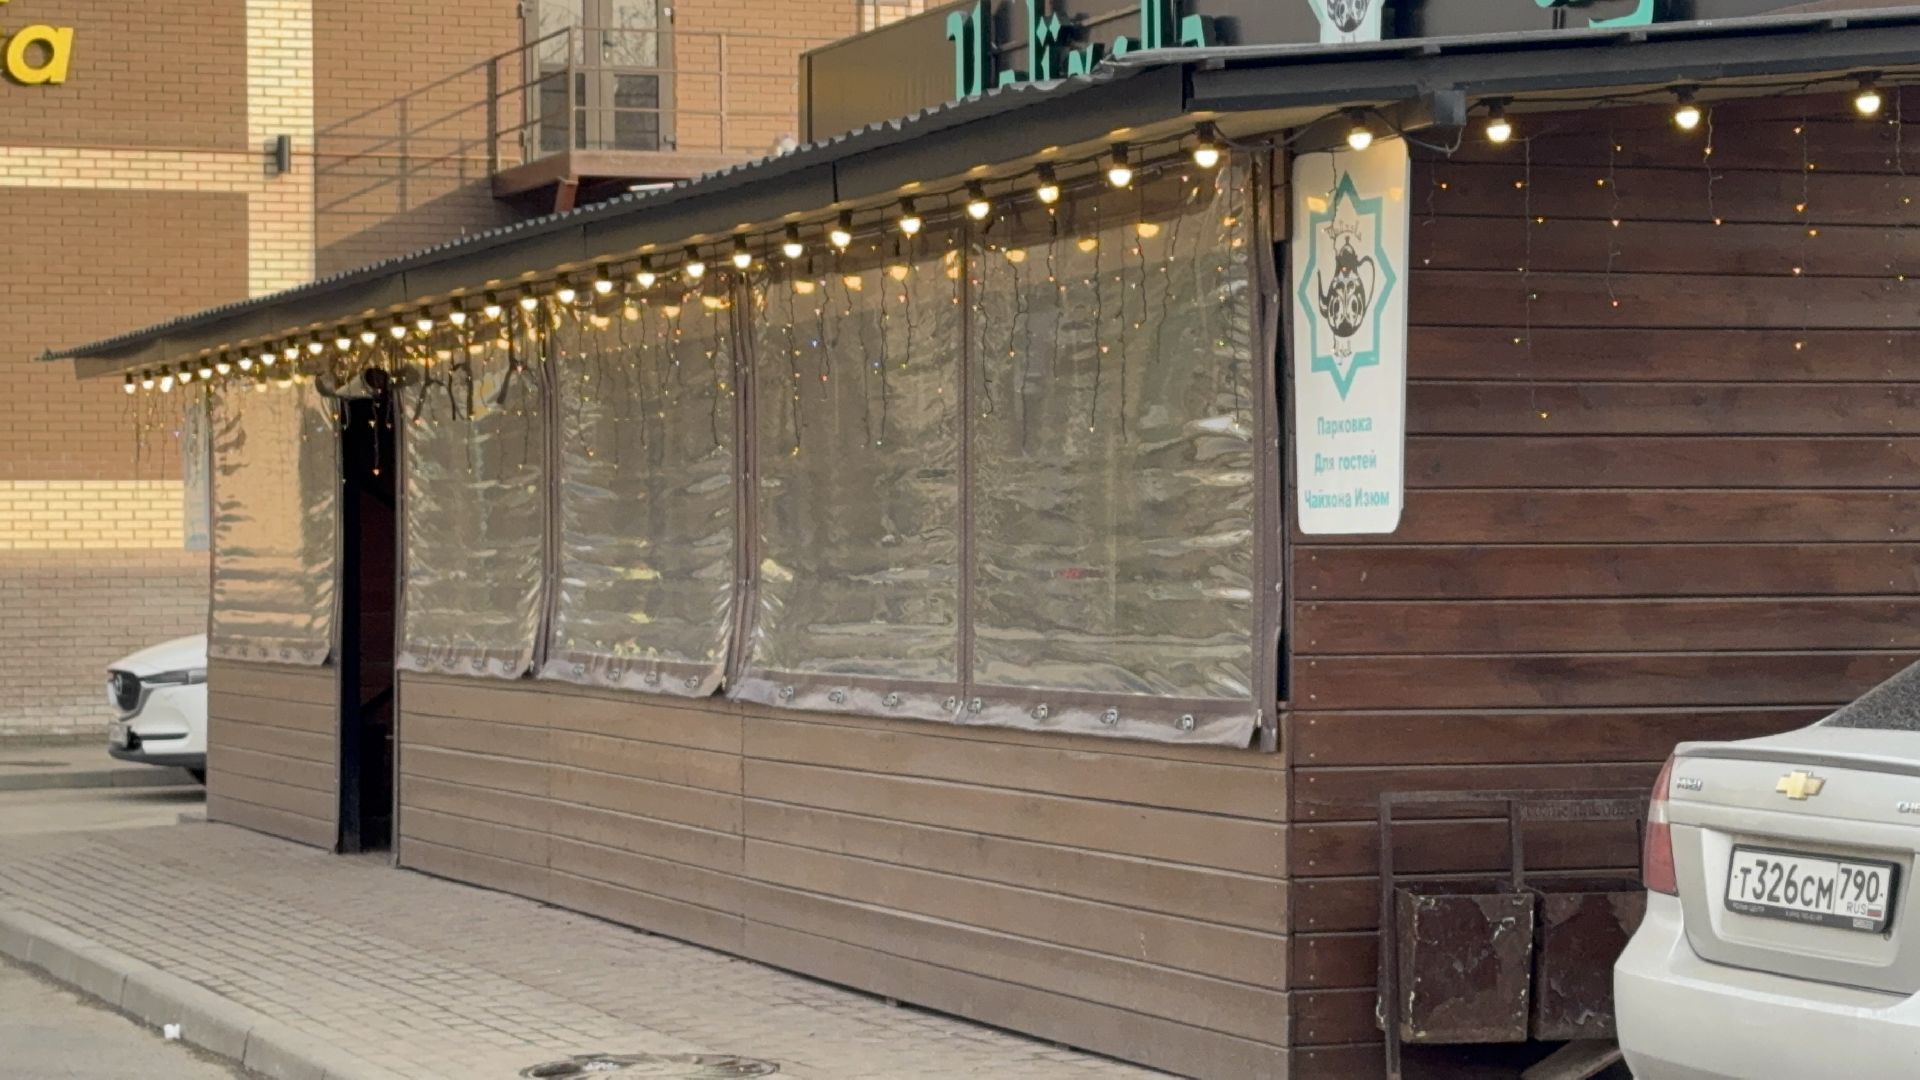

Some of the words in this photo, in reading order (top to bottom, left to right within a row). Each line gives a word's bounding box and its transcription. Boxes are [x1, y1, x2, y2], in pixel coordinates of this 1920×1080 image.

[1317, 416, 1373, 440] Парковка
[1314, 453, 1336, 476] Для
[1338, 449, 1377, 471] гостей
[1304, 488, 1352, 509] Чайхона
[1354, 487, 1390, 508] Изюм
[1740, 859, 1834, 911] Т326СМ
[1840, 867, 1880, 903] 790
[1846, 901, 1867, 916] RUS
